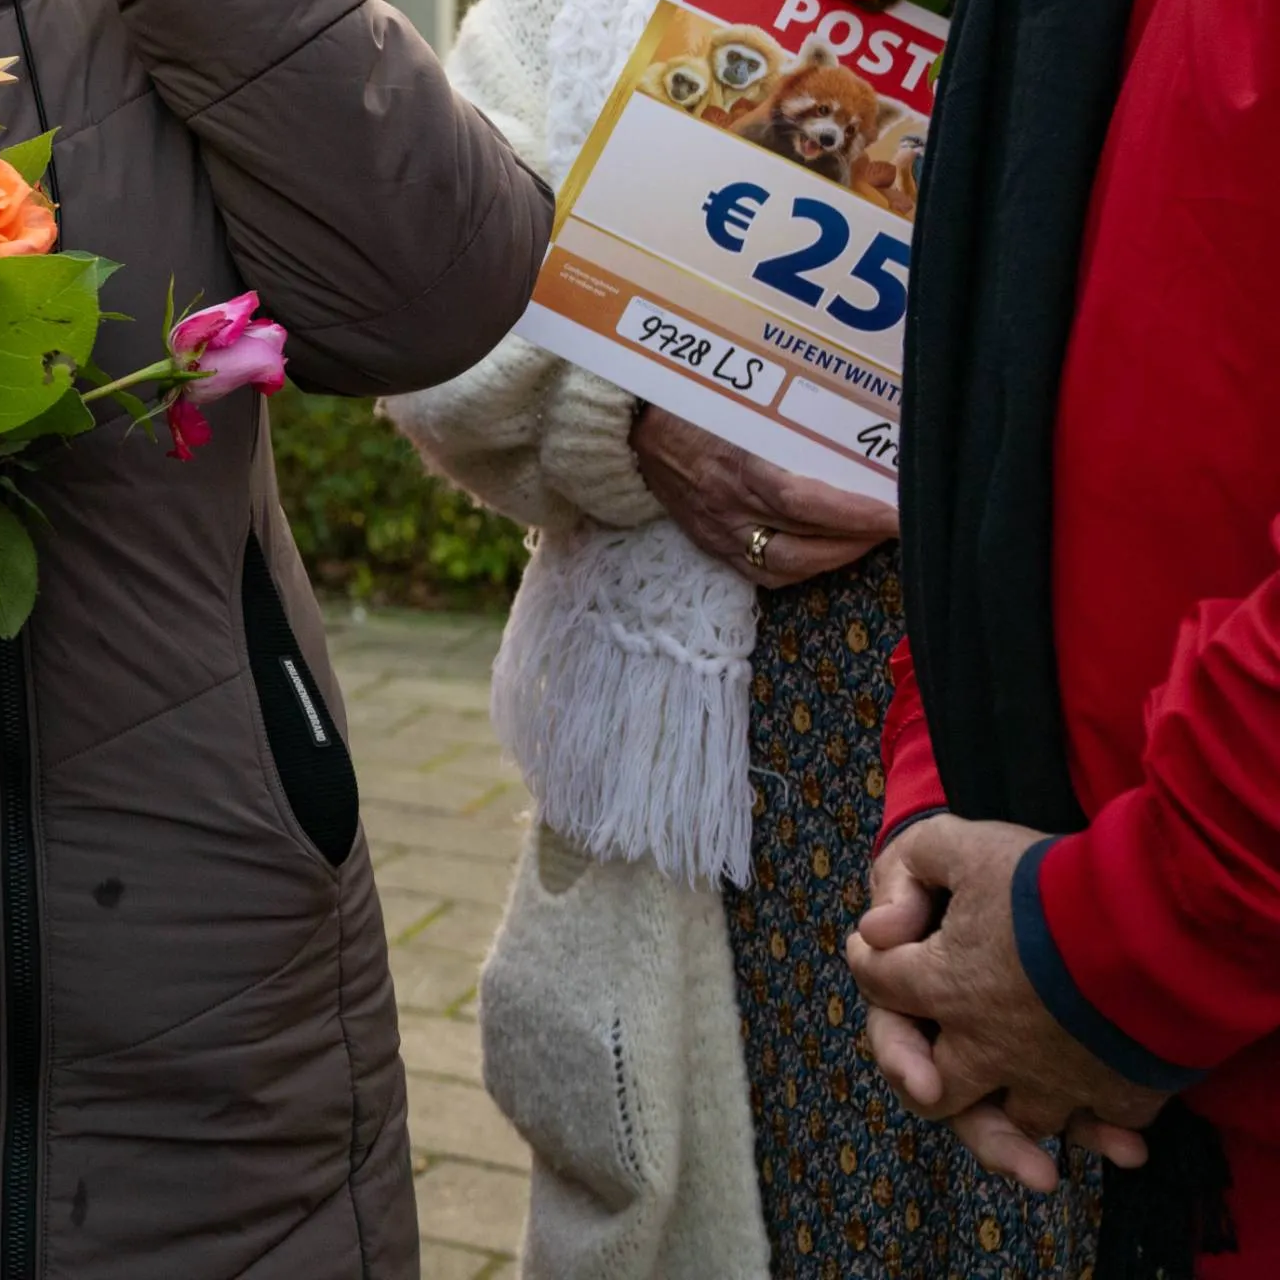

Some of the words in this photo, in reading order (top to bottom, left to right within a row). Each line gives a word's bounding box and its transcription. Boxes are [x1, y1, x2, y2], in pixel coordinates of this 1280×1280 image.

[638, 316, 712, 367] 9728
[713, 345, 764, 390] LS
[762, 322, 902, 405] VIJFENTWINT
